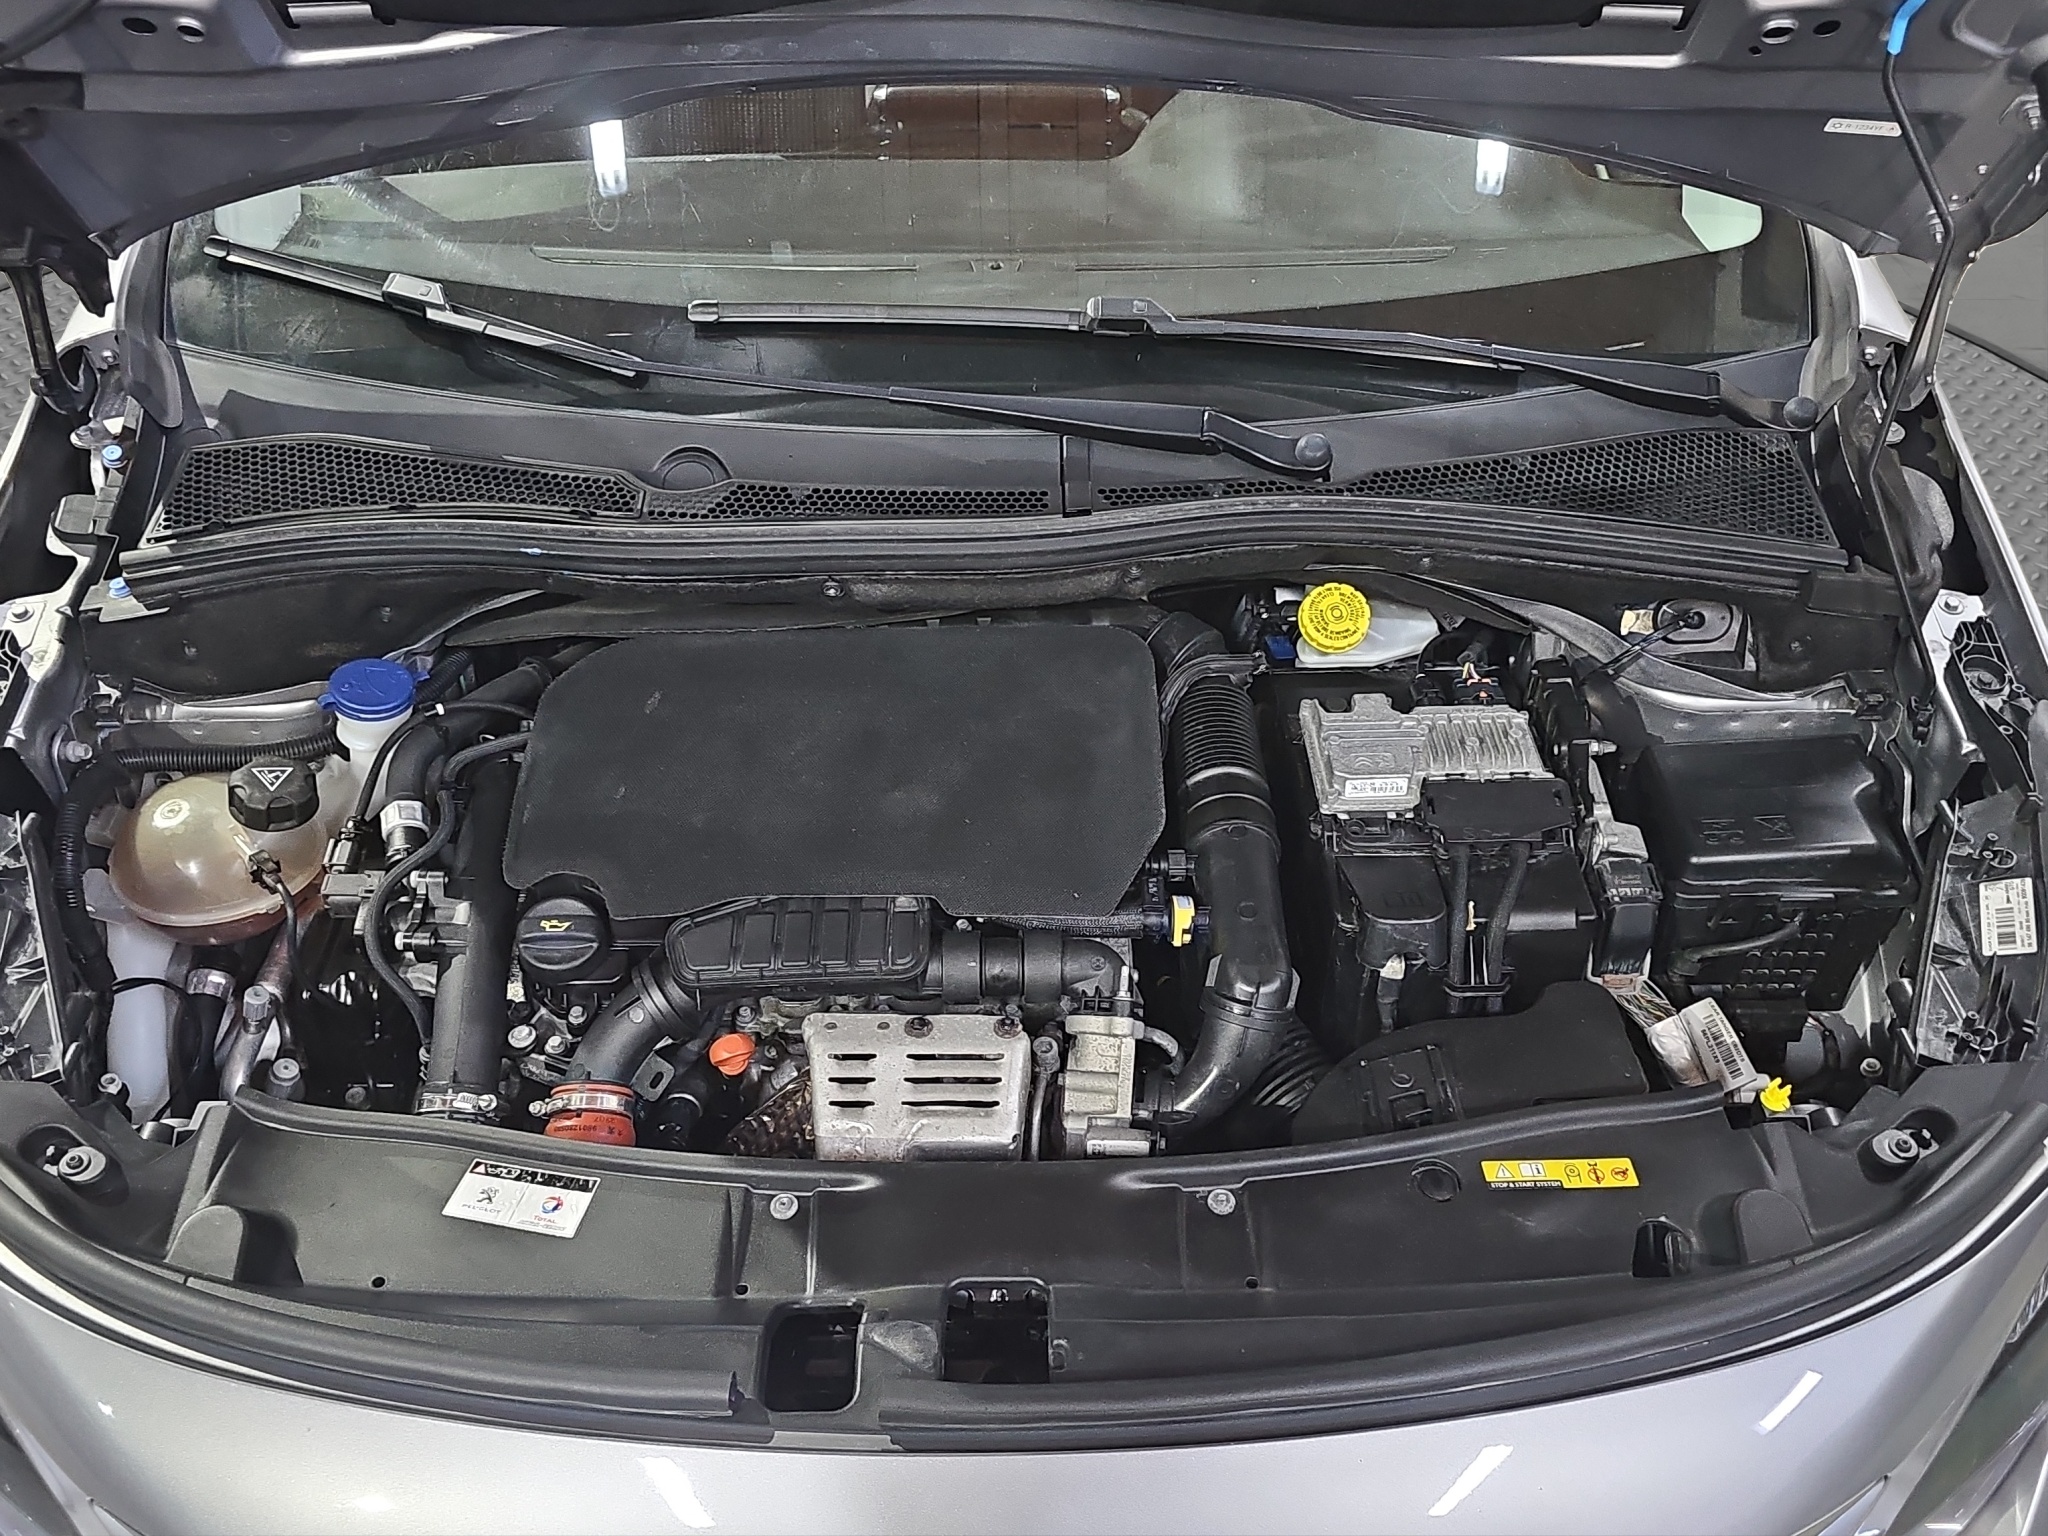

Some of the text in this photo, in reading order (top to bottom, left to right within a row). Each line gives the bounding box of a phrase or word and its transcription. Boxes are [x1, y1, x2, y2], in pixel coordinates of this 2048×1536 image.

[1708, 1001, 1721, 1017] LEAR
[1490, 1181, 1508, 1189] STOP
[533, 1214, 557, 1224] TOTAL
